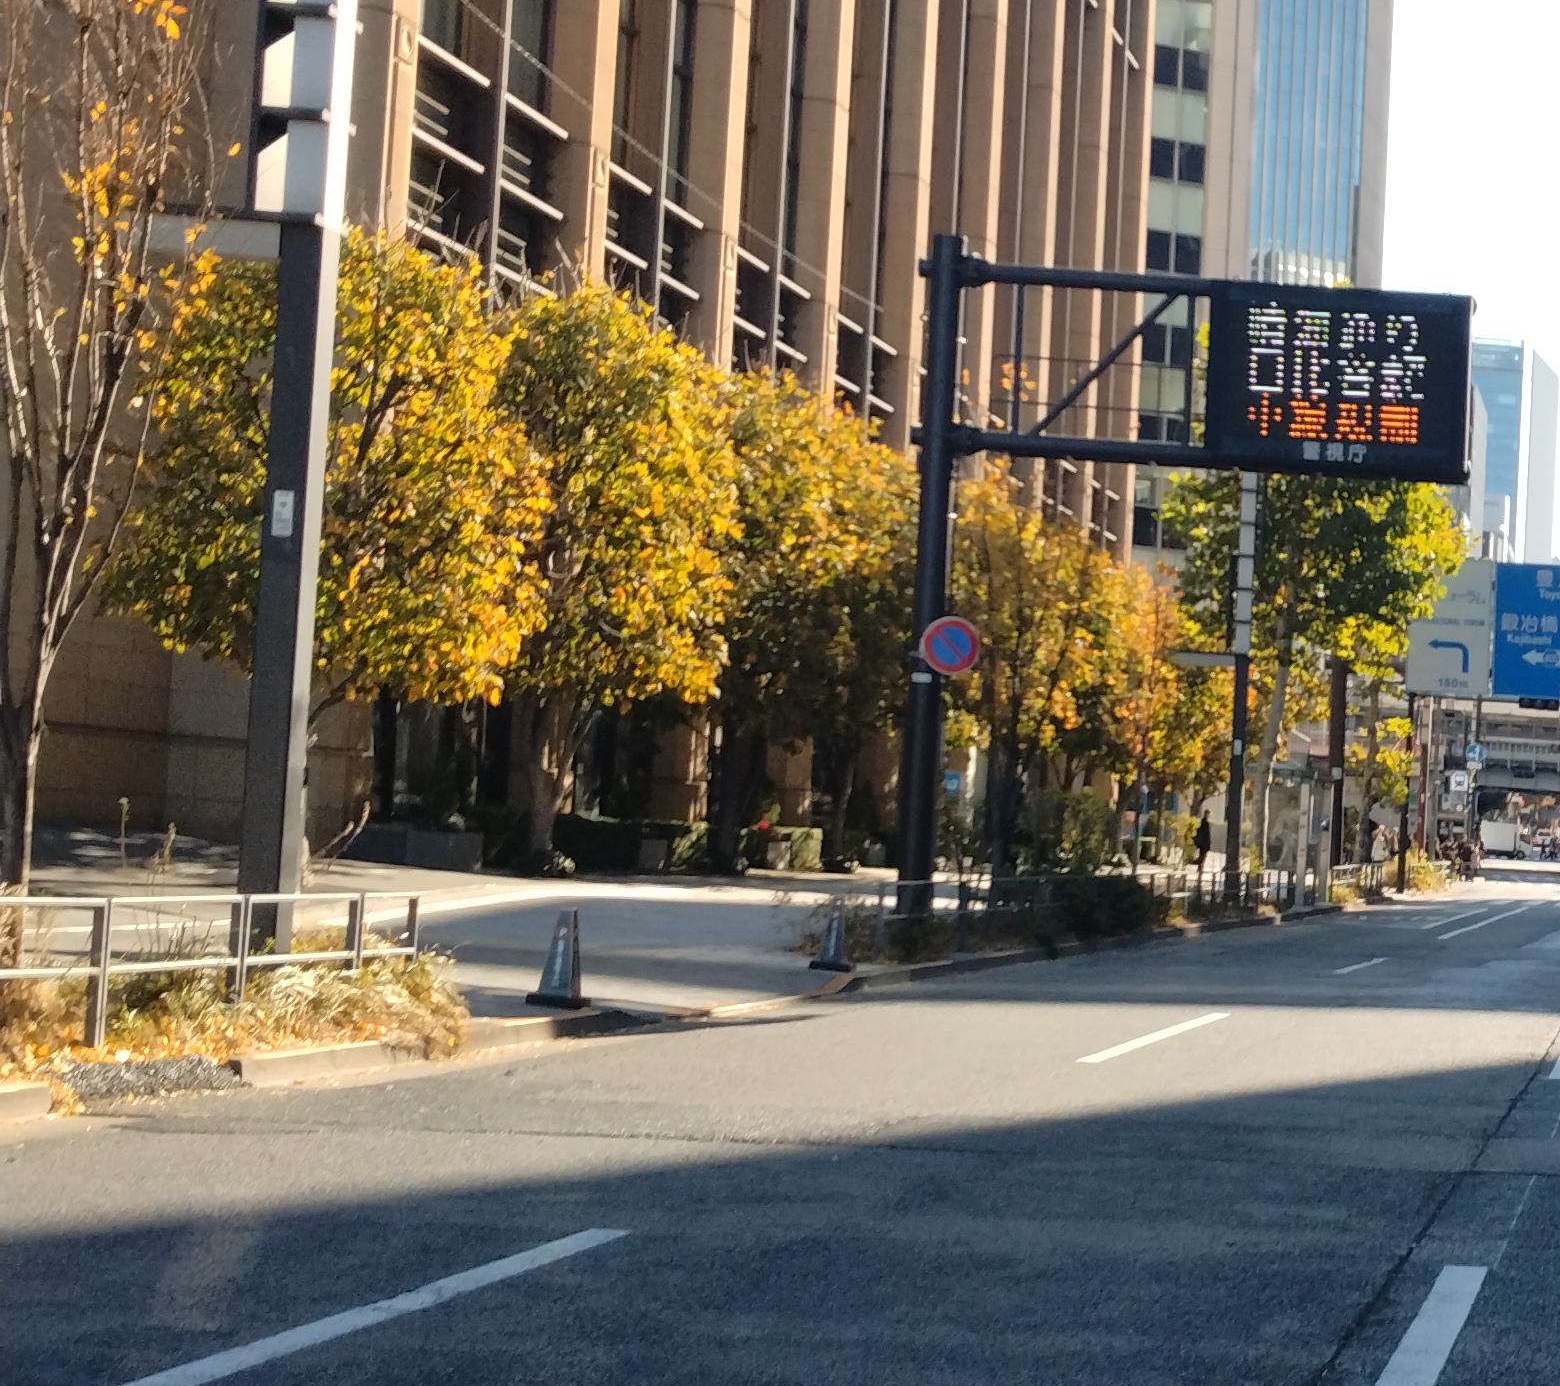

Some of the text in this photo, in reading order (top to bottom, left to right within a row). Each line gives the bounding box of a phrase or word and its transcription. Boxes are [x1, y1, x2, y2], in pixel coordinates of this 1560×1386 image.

[1302, 440, 1367, 464] 警視庁
[1506, 633, 1553, 646] Kajibashi
[1438, 678, 1469, 689] 150m
